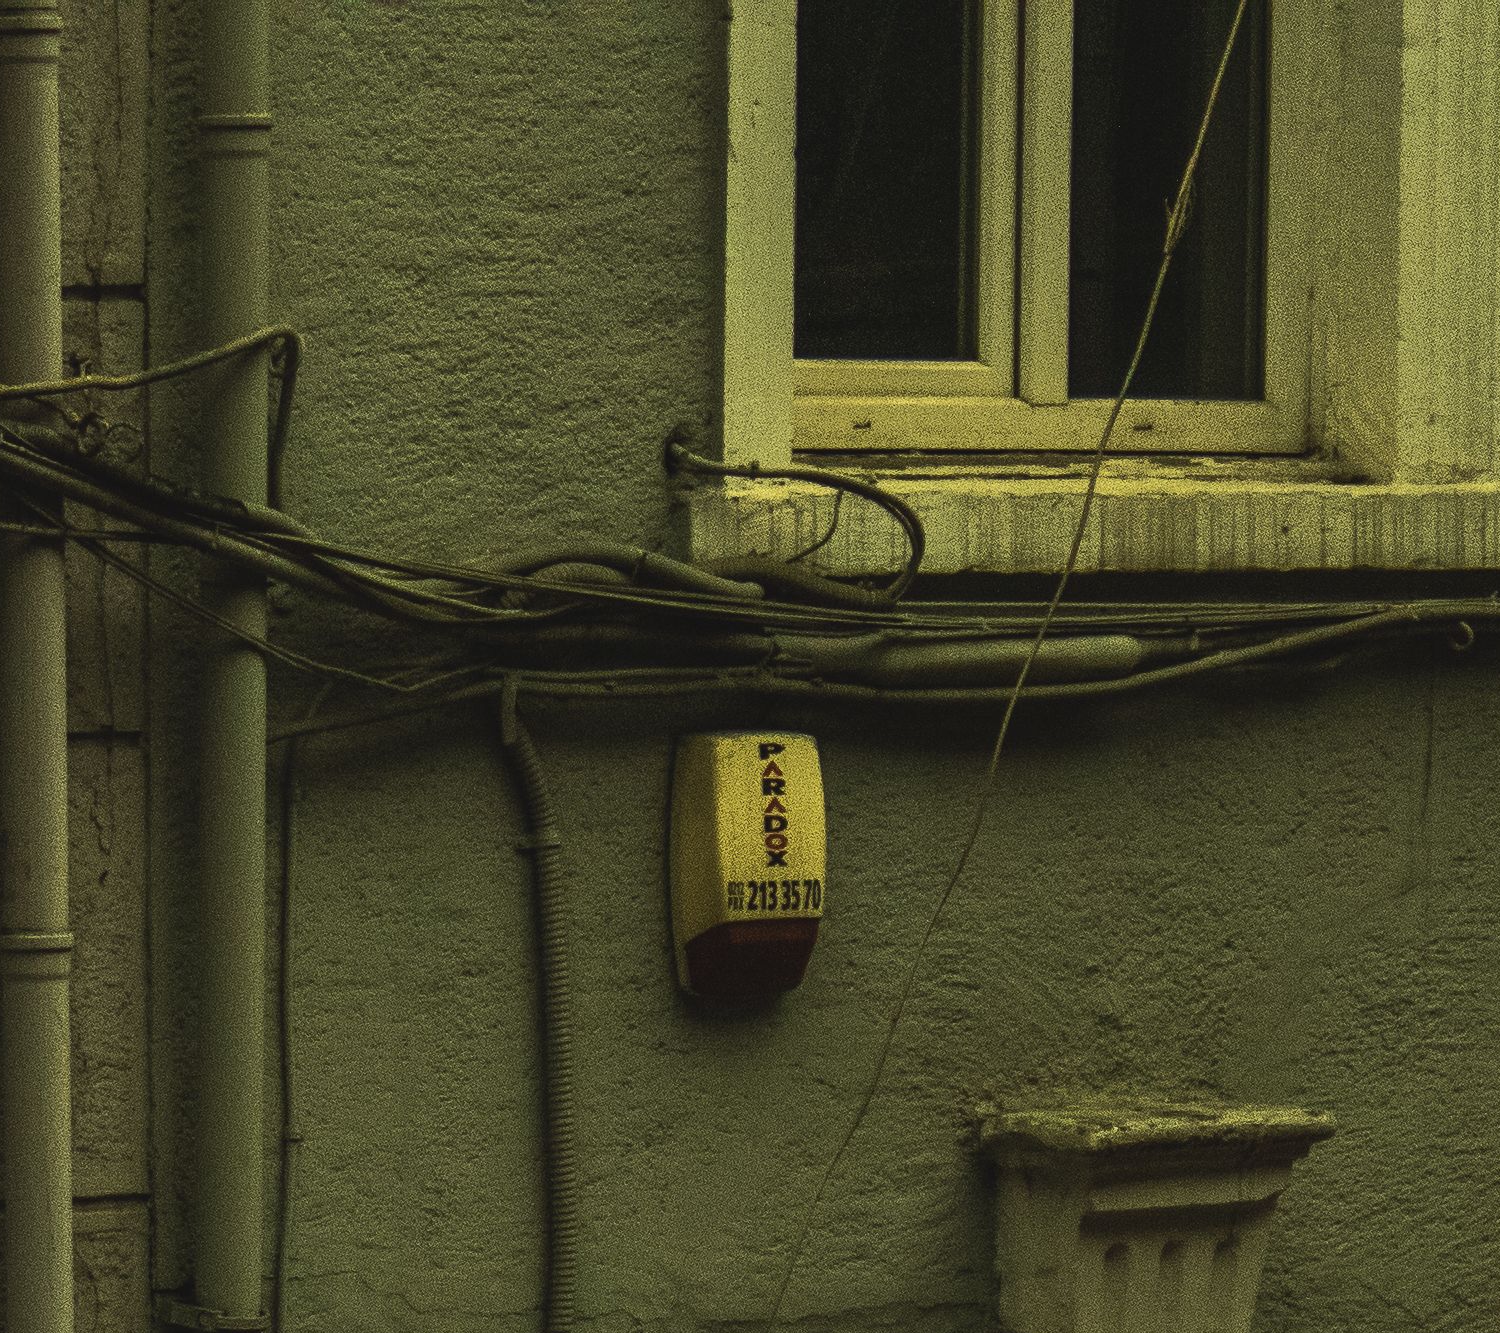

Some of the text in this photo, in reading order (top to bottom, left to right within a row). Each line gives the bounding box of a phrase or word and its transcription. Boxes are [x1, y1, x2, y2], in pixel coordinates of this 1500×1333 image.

[758, 743, 788, 867] PARADOX
[747, 879, 822, 911] 213 35 70
